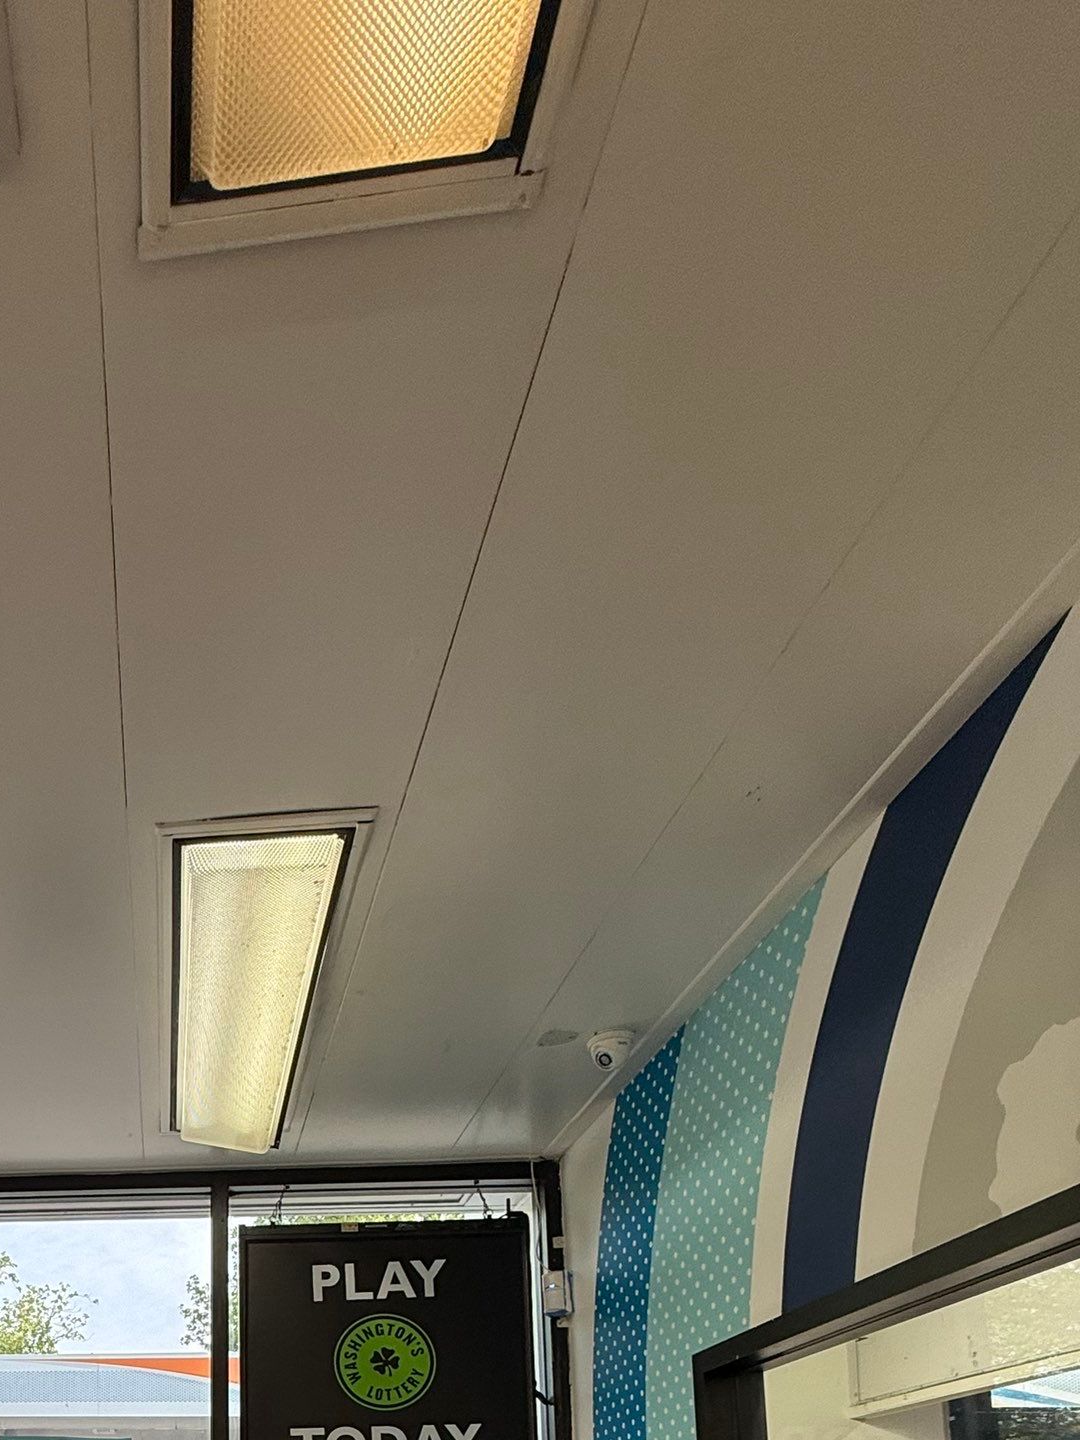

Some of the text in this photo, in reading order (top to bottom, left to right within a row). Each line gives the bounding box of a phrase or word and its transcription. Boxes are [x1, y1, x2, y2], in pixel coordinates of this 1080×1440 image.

[311, 1259, 446, 1302] PLAY
[344, 1322, 425, 1385] WASHINGTON'S
[366, 1368, 425, 1401] LOTTERY
